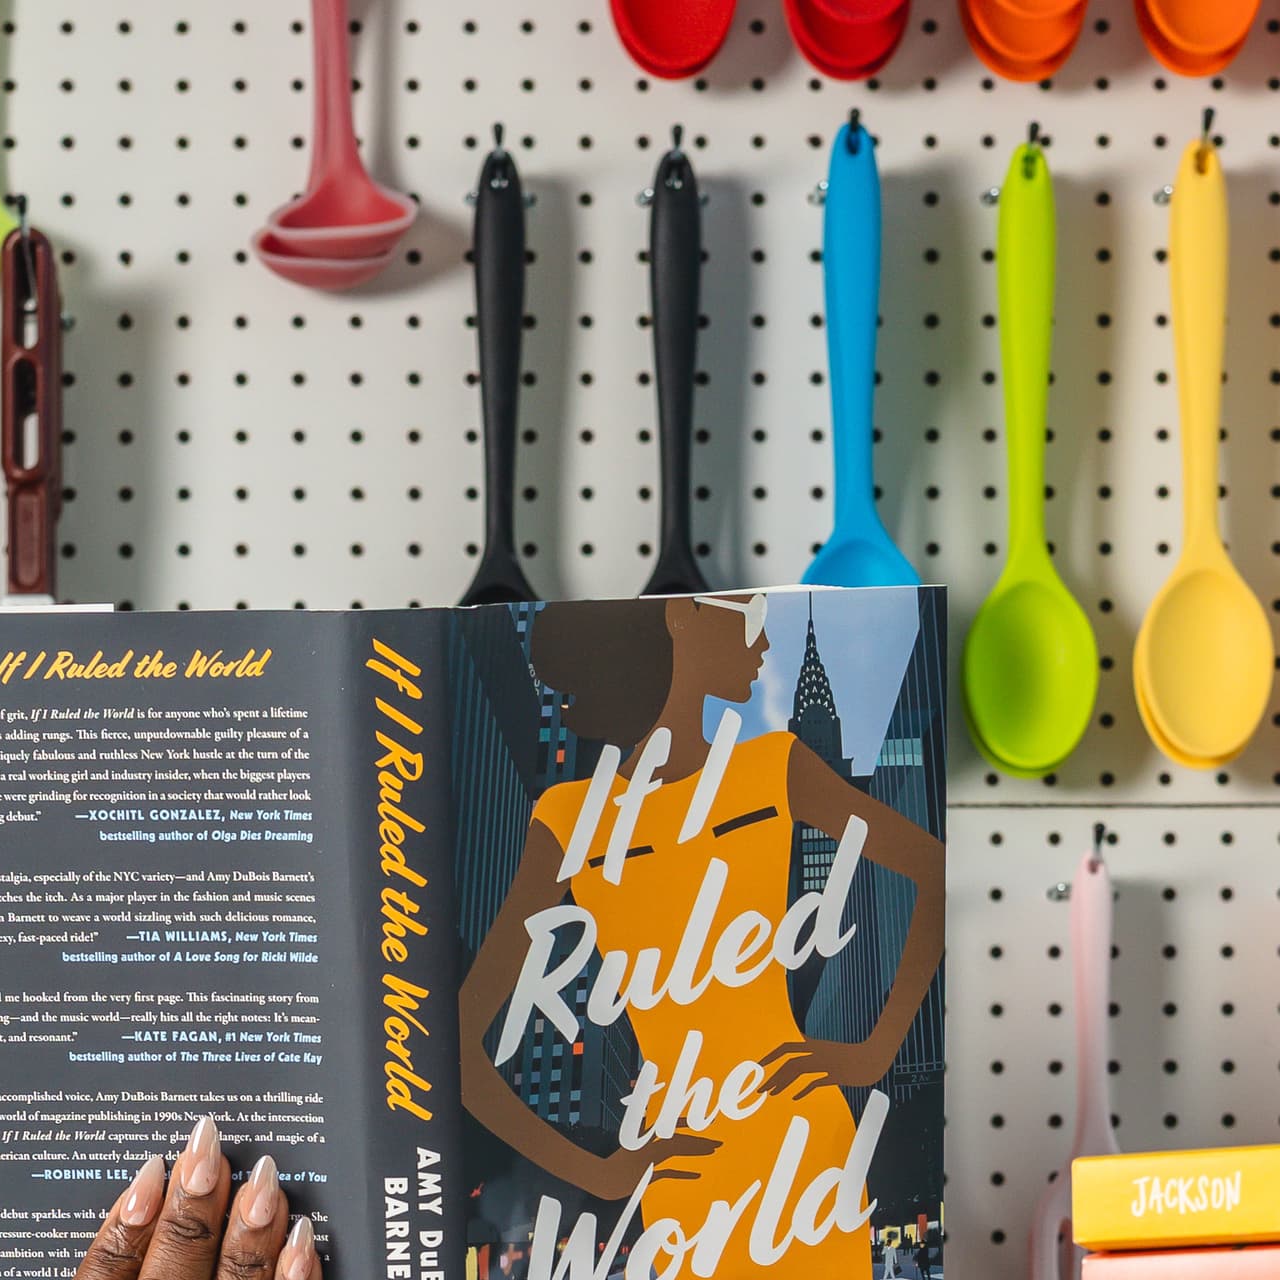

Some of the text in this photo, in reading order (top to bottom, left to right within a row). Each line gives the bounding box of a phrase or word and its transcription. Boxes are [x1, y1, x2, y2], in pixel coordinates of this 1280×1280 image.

[23, 651, 47, 680] I
[44, 649, 134, 681] Ruled
[132, 650, 177, 679] the
[183, 648, 273, 680] World
[556, 707, 743, 886] If I
[75, 810, 312, 822] —XOCHITL GONZALEZ, New York Times
[100, 830, 313, 843] bestselling author of Olga Dies Dreaming
[365, 638, 433, 1121] If I Ruled the World
[126, 931, 317, 943] —TIA WILLIAMS, New York Times
[494, 813, 868, 1068] Ruled
[63, 952, 318, 963] bestselling author of A Love Song for Ricki Wilde
[122, 1031, 321, 1043] —KATE FAGAN, #1 New York Times
[69, 1051, 322, 1065] bestselling author of The Three Lives of Cate Kay
[617, 1030, 767, 1152] the
[32, 1169, 101, 1179] —ROBINNE
[107, 1168, 134, 1181] LEE,
[416, 1146, 443, 1216] AMY
[1130, 1170, 1241, 1218] JACKSON
